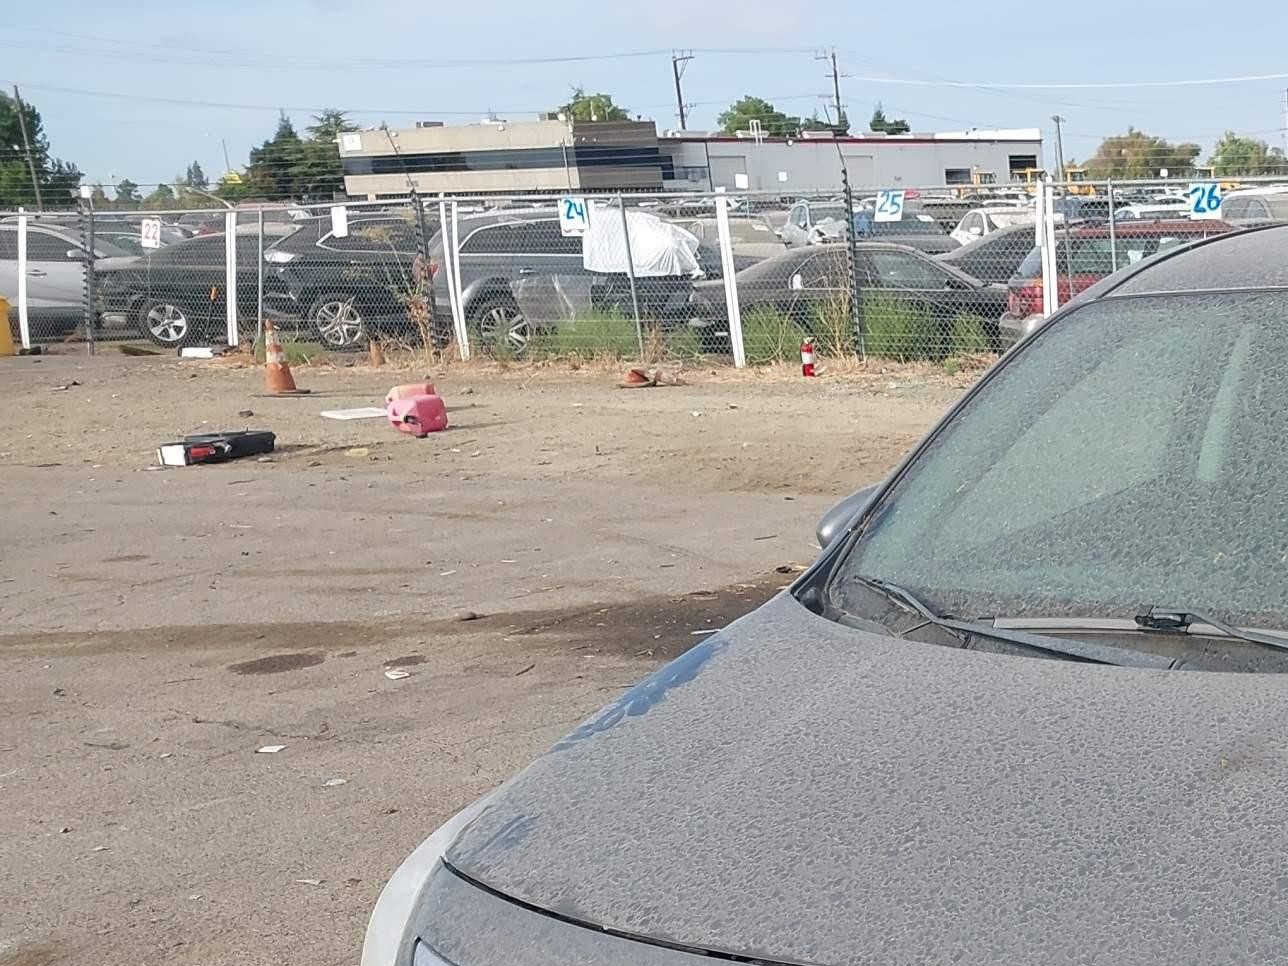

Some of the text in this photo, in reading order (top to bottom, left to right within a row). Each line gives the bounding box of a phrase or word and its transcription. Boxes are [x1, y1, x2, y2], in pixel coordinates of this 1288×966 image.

[878, 190, 902, 215] 25
[1190, 183, 1220, 213] 26
[564, 199, 585, 224] 24
[145, 223, 158, 240] 22
